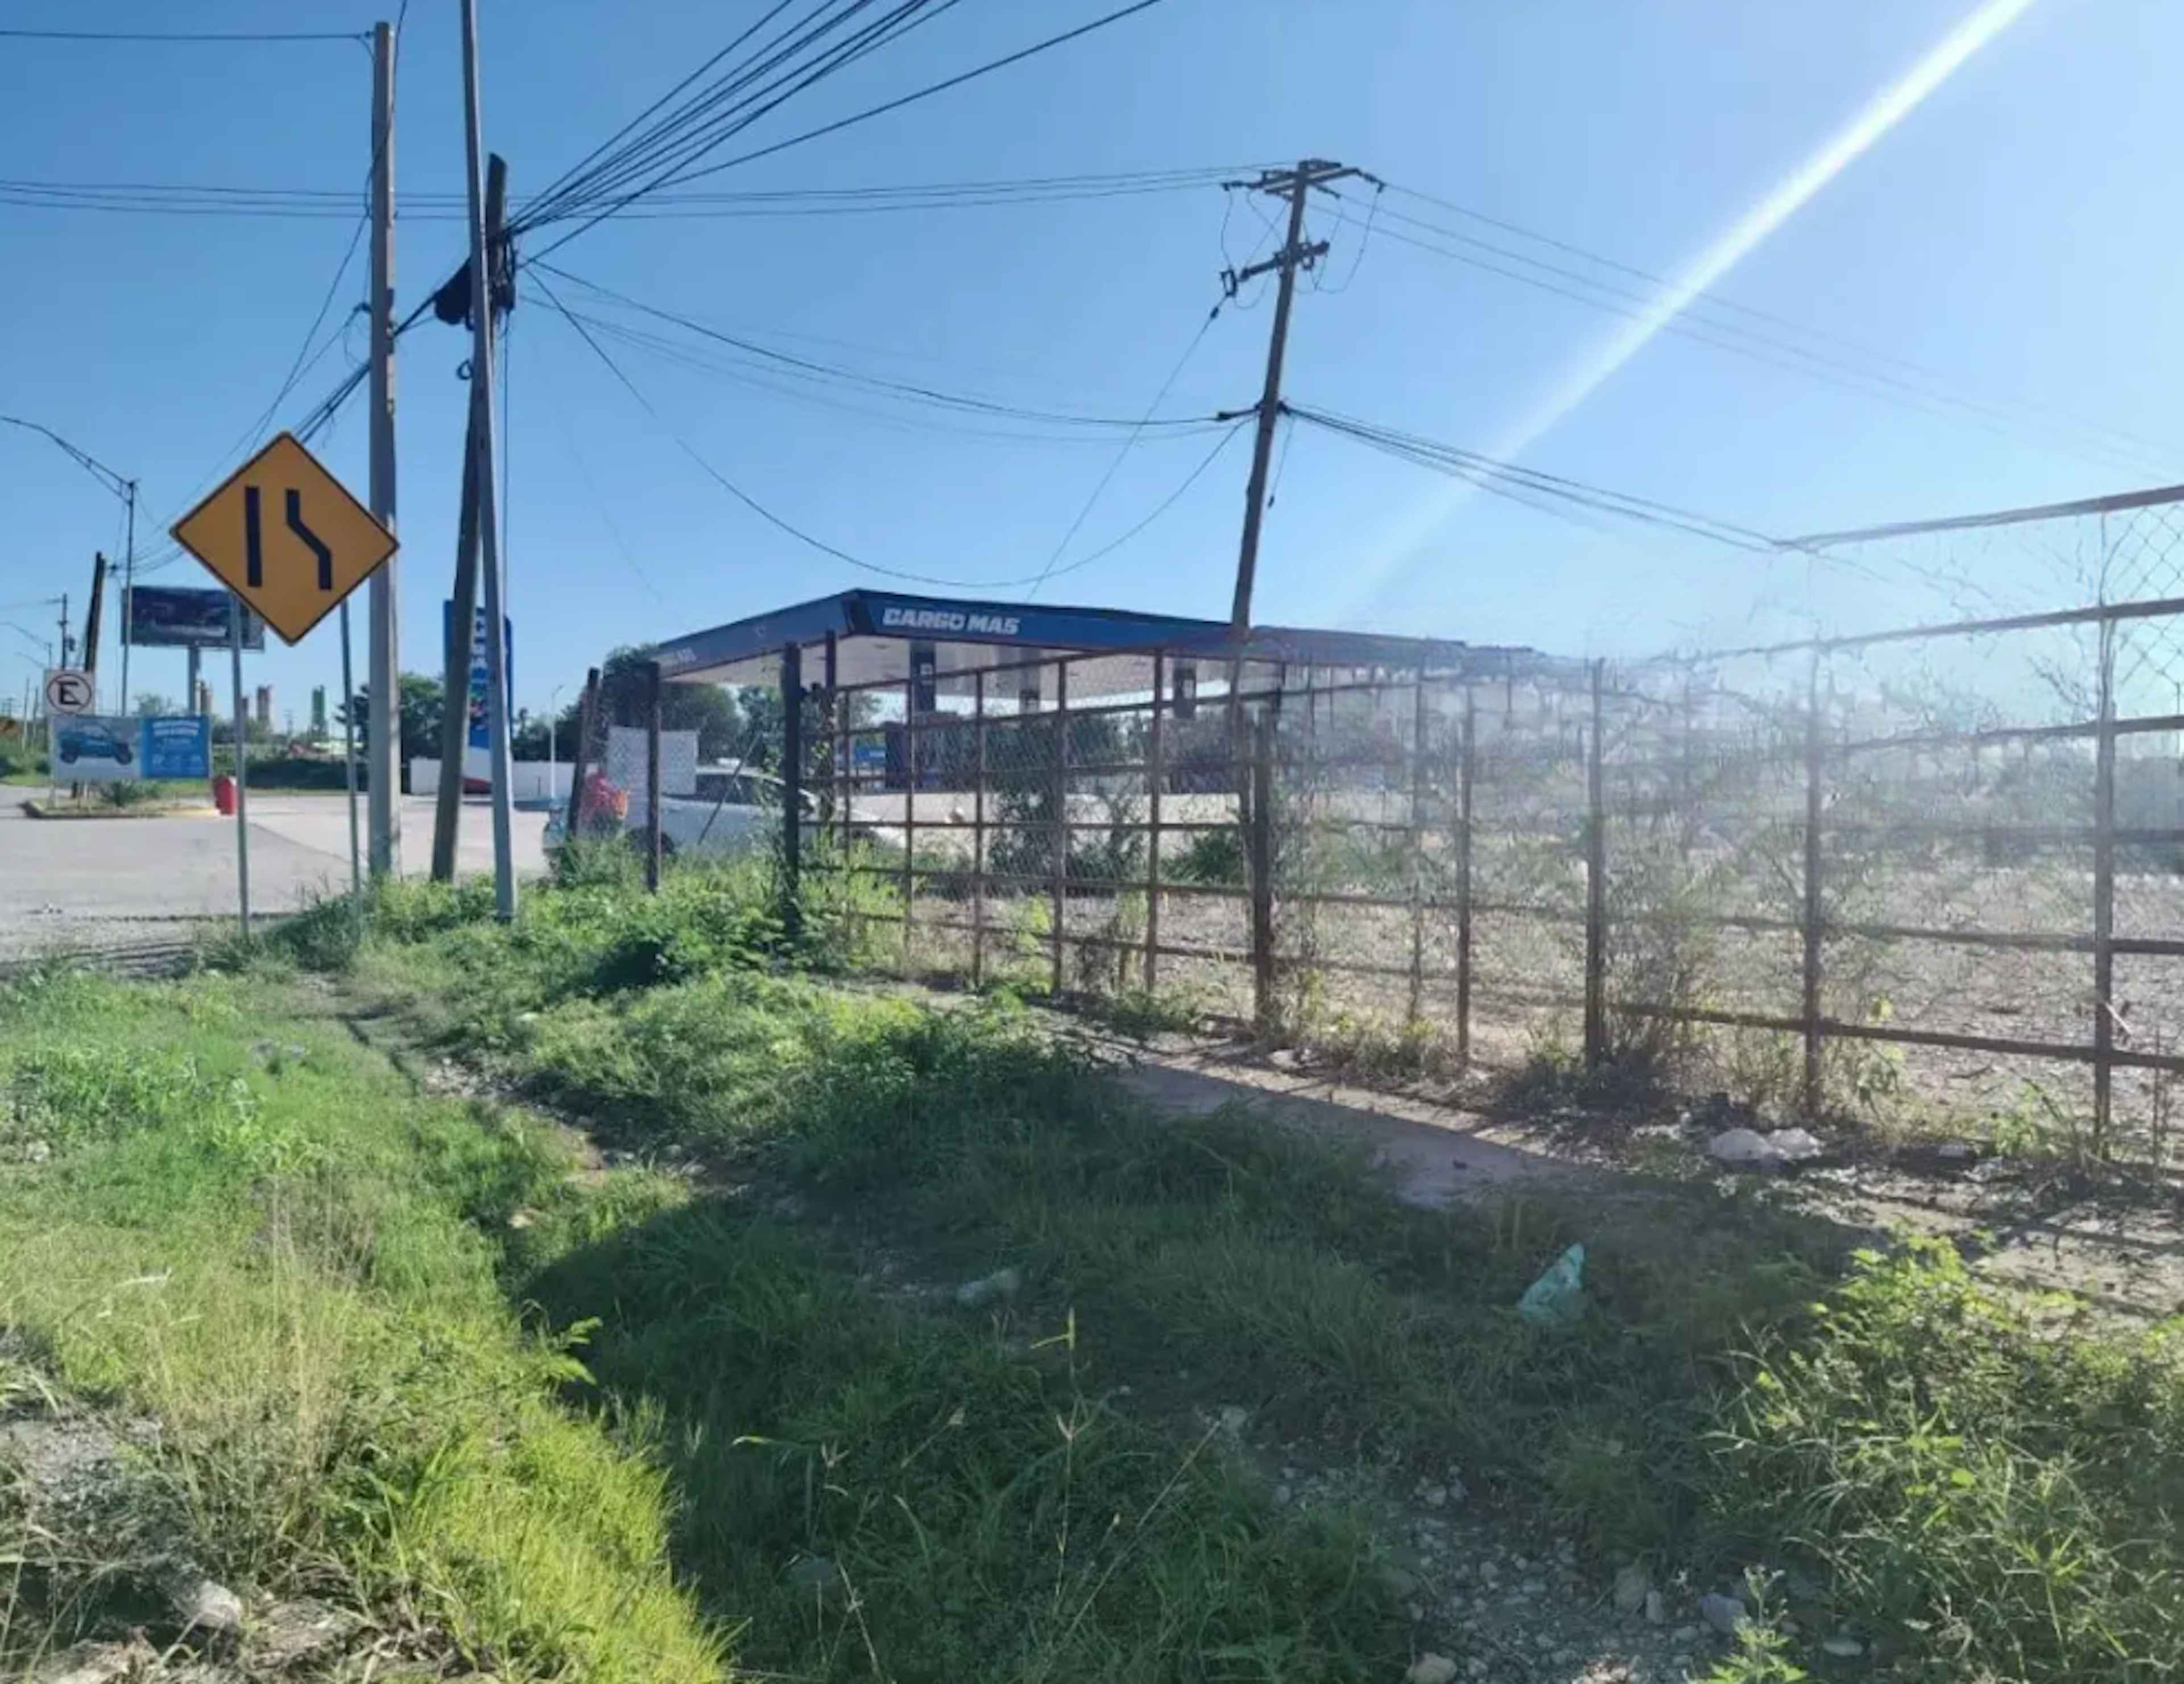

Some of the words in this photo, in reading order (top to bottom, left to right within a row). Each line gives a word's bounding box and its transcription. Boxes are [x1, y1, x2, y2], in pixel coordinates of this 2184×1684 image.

[882, 608, 966, 630] CARGO
[967, 613, 1020, 635] MAS
[59, 681, 80, 705] E
